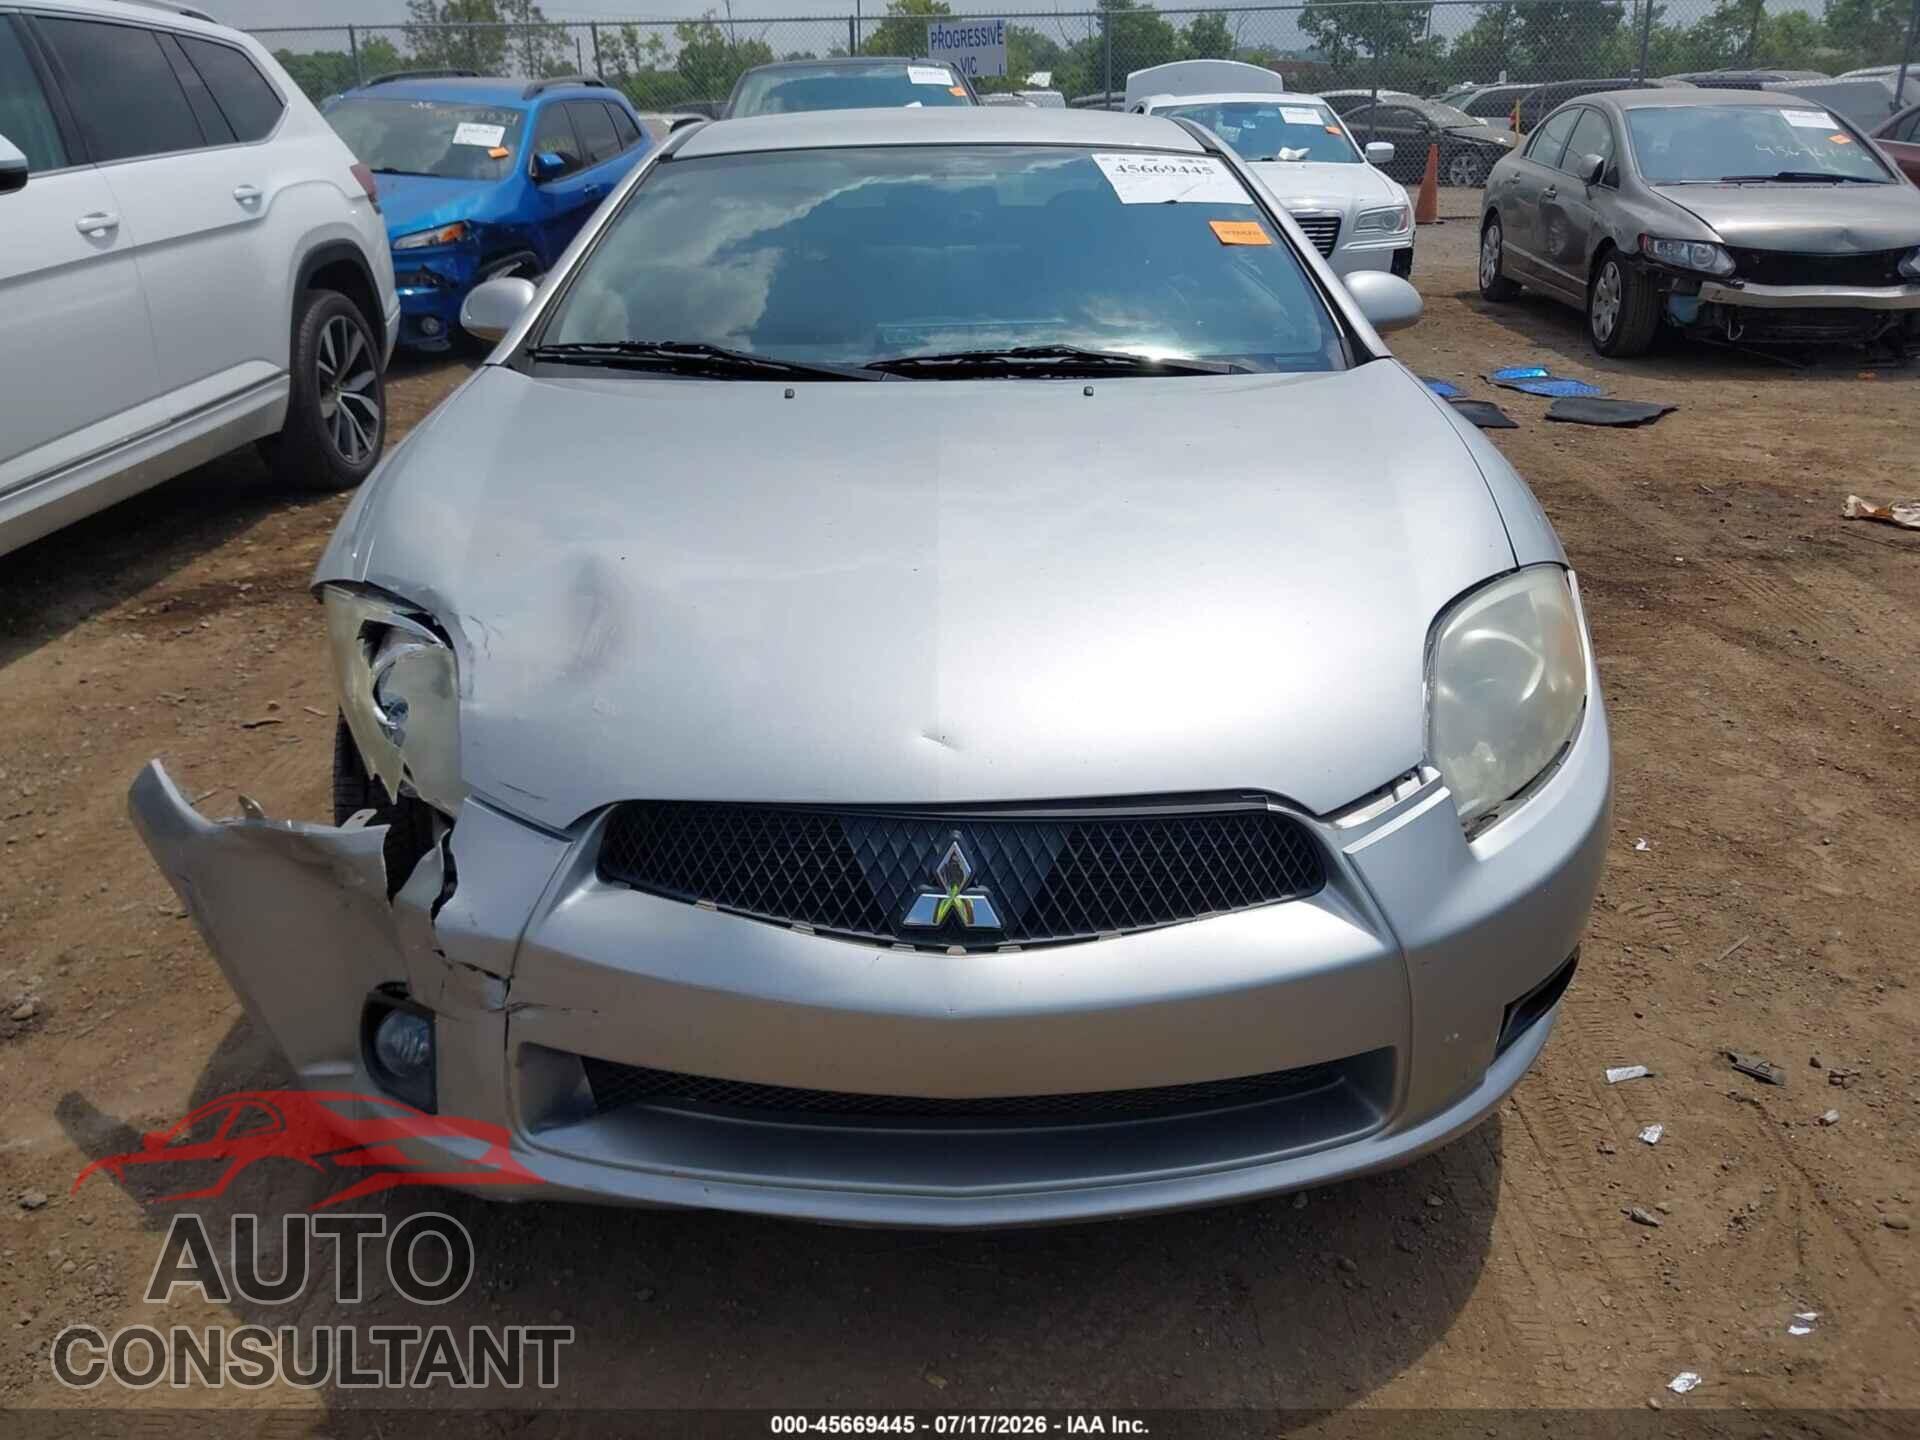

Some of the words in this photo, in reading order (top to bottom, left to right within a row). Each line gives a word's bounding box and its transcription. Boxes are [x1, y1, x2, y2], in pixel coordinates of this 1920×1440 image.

[931, 26, 1004, 50] PROGRESSIVE
[960, 56, 977, 74] VIC
[1115, 163, 1216, 176] 45669445
